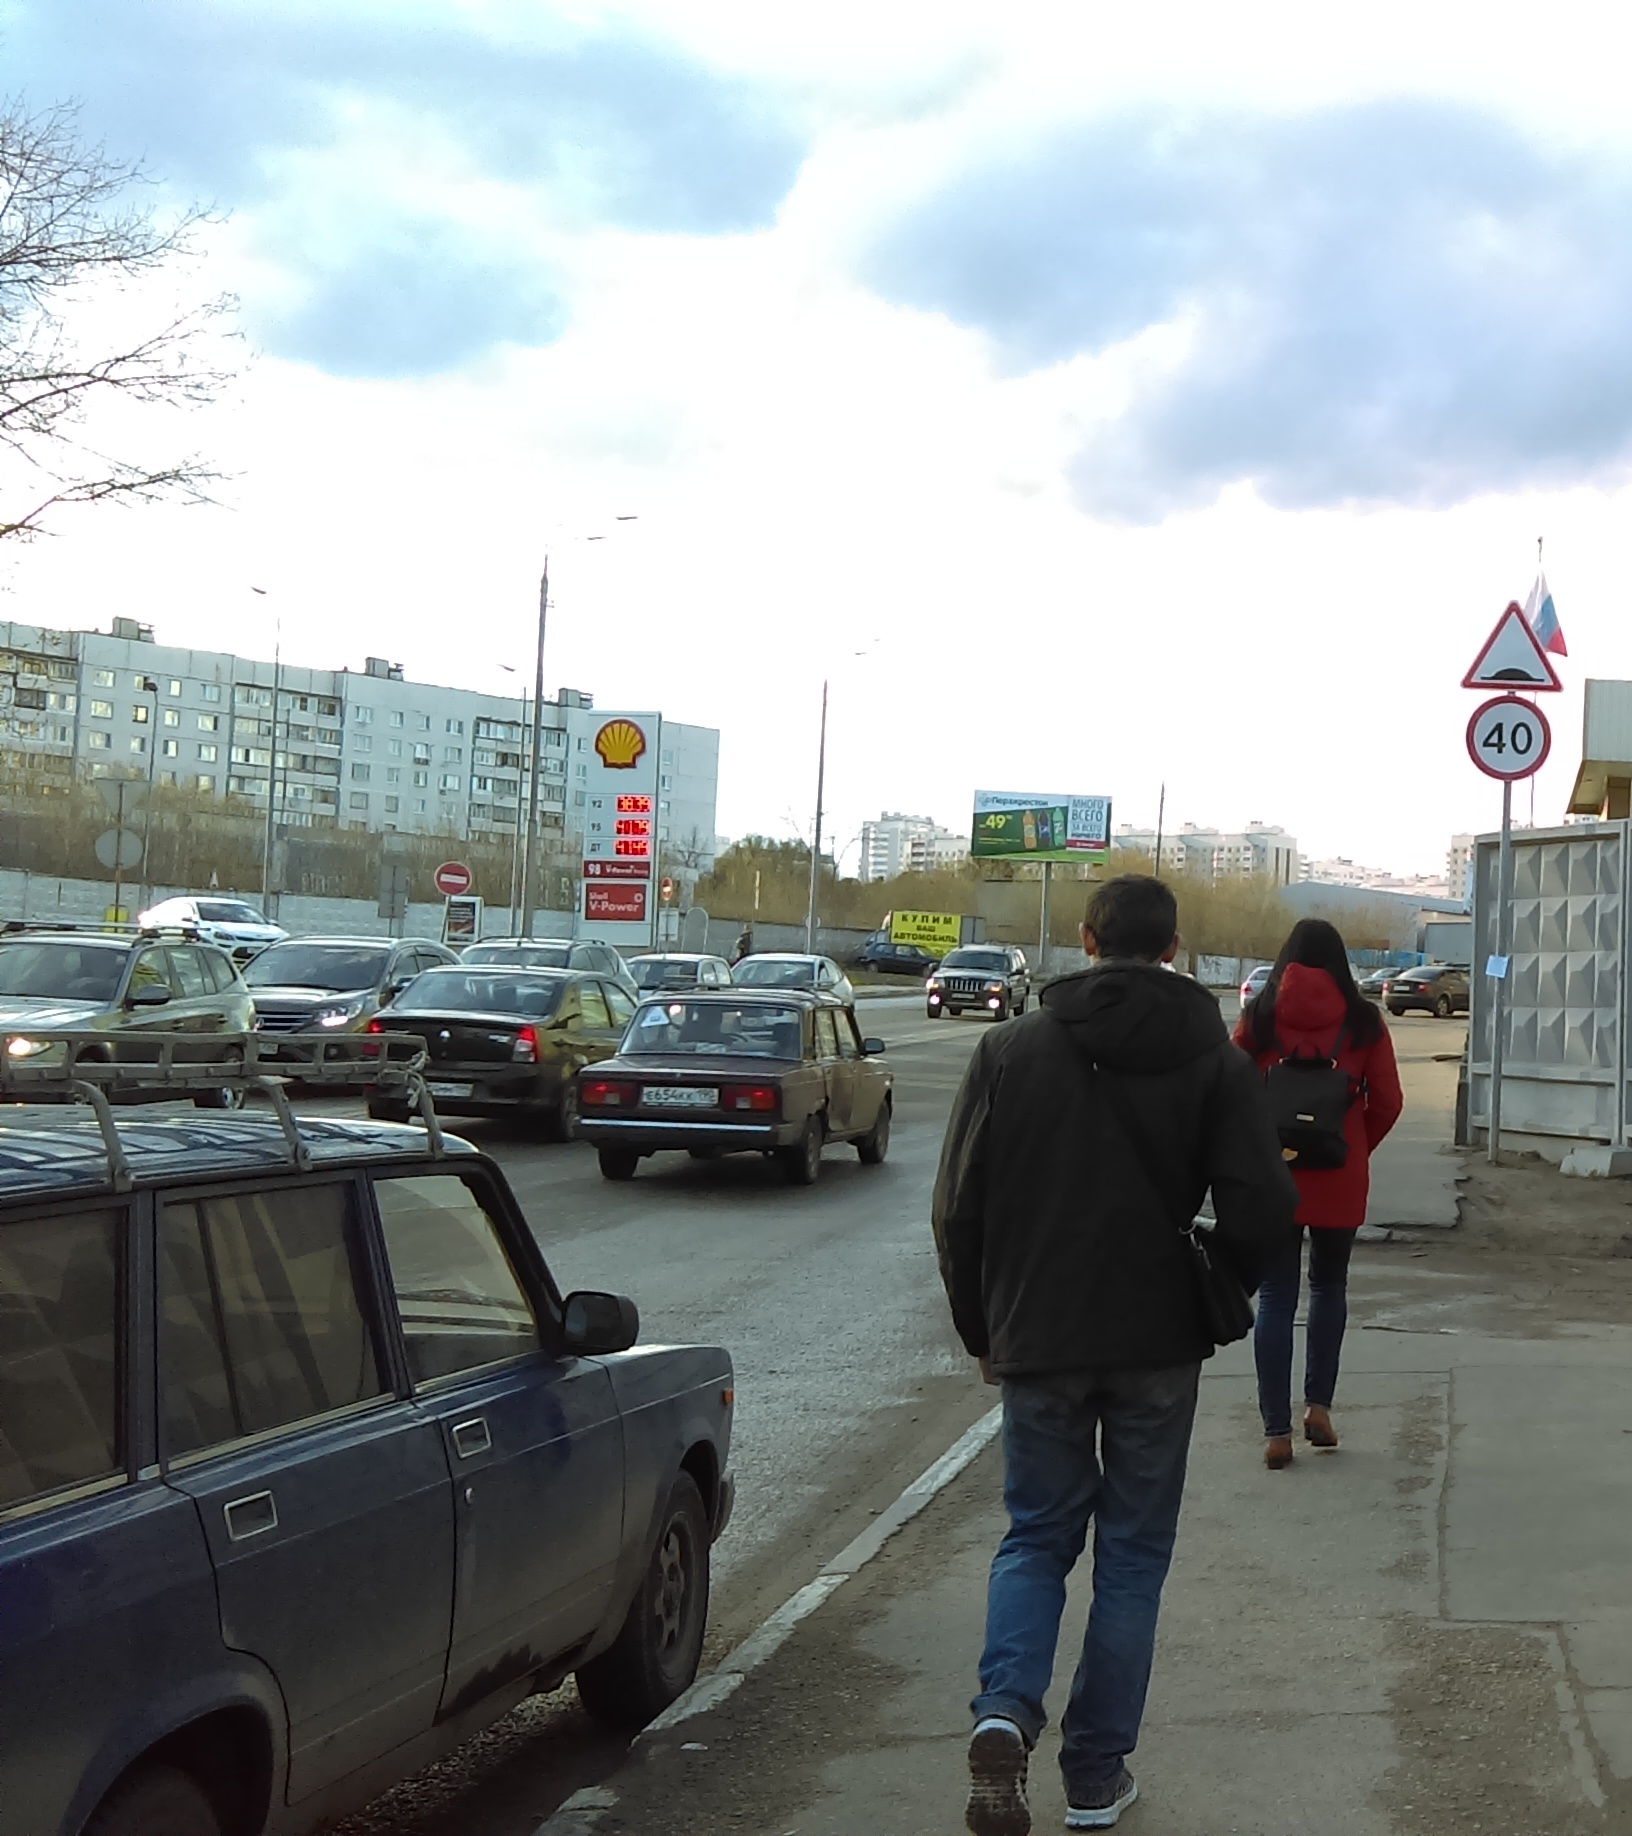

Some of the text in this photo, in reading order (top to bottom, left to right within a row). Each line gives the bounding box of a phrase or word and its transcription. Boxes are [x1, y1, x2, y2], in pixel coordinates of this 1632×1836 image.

[1482, 721, 1534, 755] 40
[1072, 799, 1104, 810] МНОГО
[984, 813, 1007, 829] 49
[1071, 809, 1104, 822] ВСЕГО
[588, 900, 640, 912] V-Power
[893, 932, 958, 943] АВТОМОБИЛЬ
